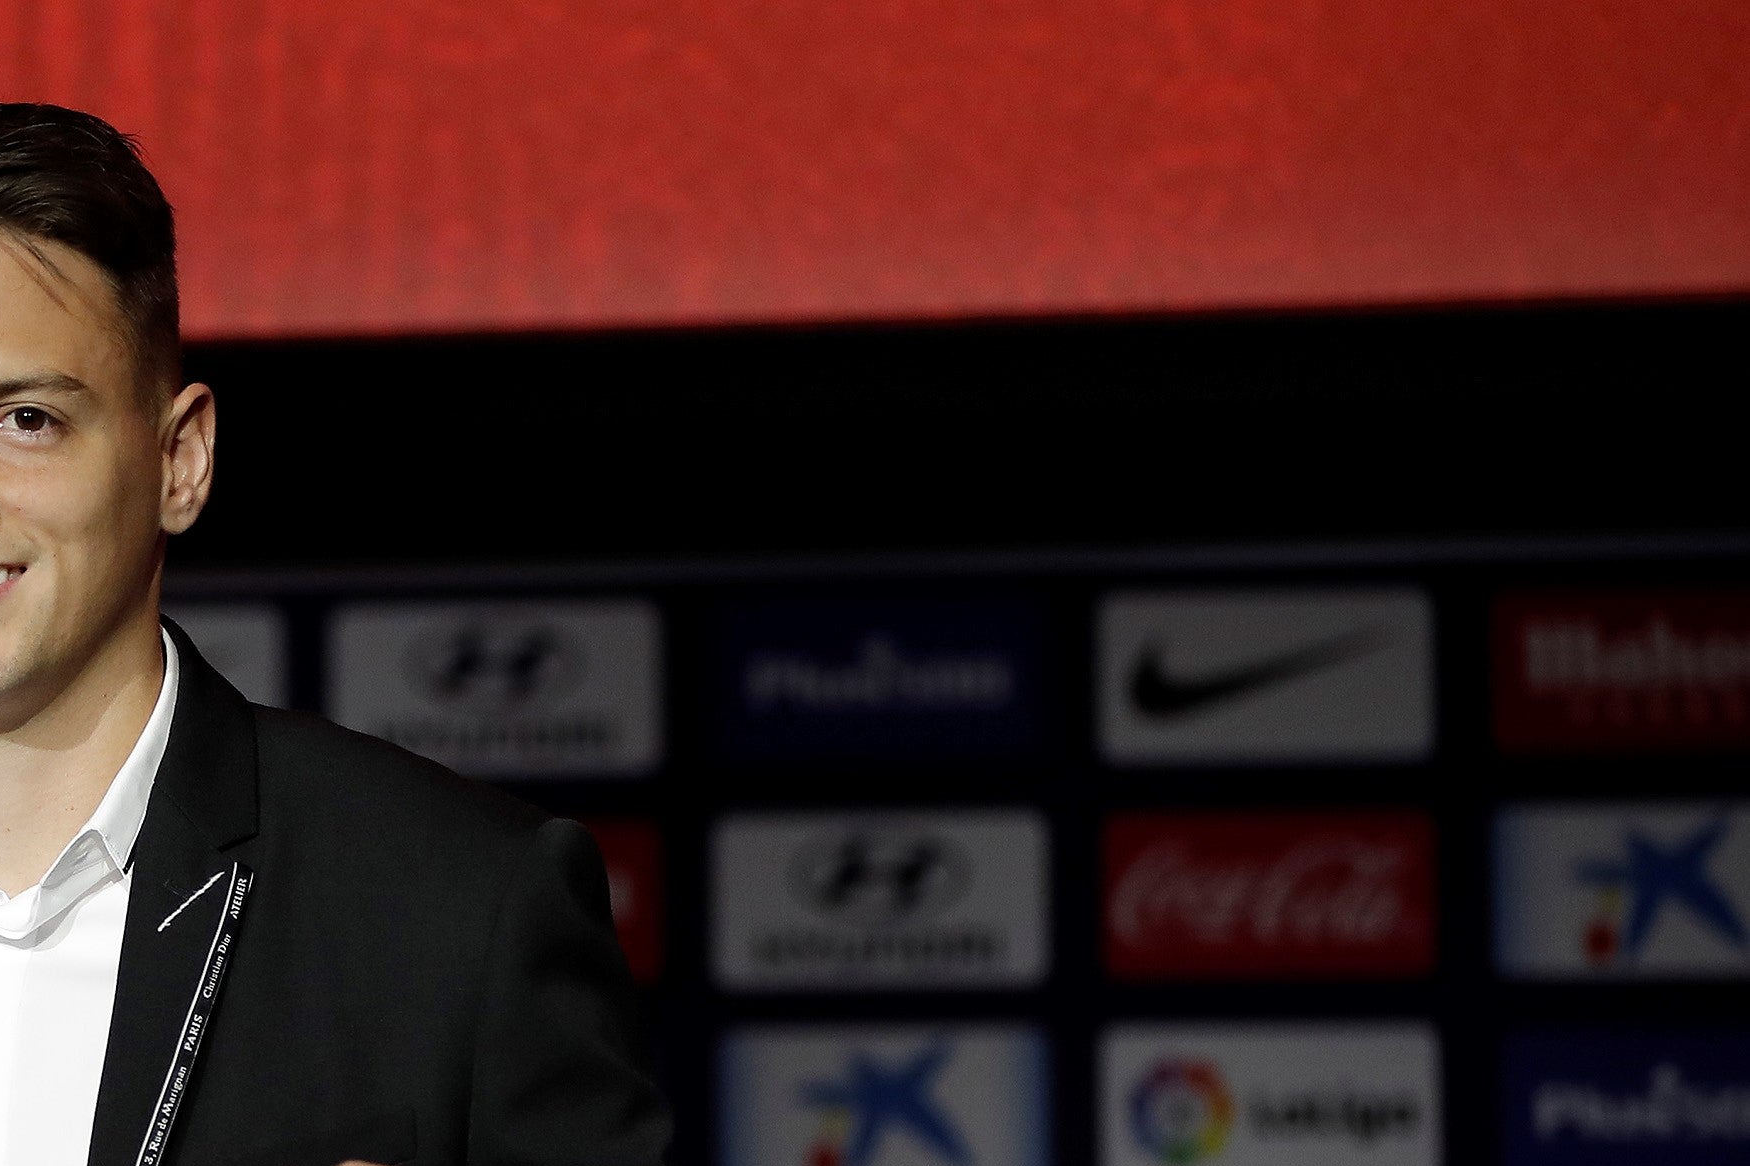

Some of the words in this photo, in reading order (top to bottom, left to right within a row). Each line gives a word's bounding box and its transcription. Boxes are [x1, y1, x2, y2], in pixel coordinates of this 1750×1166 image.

[229, 876, 248, 920] ATELIER
[216, 932, 232, 955] Dior
[202, 953, 225, 1000] Christian
[183, 1013, 204, 1053] PARIS
[161, 1065, 188, 1118] Marignan
[148, 1129, 164, 1153] Rue
[160, 1117, 169, 1130] de
